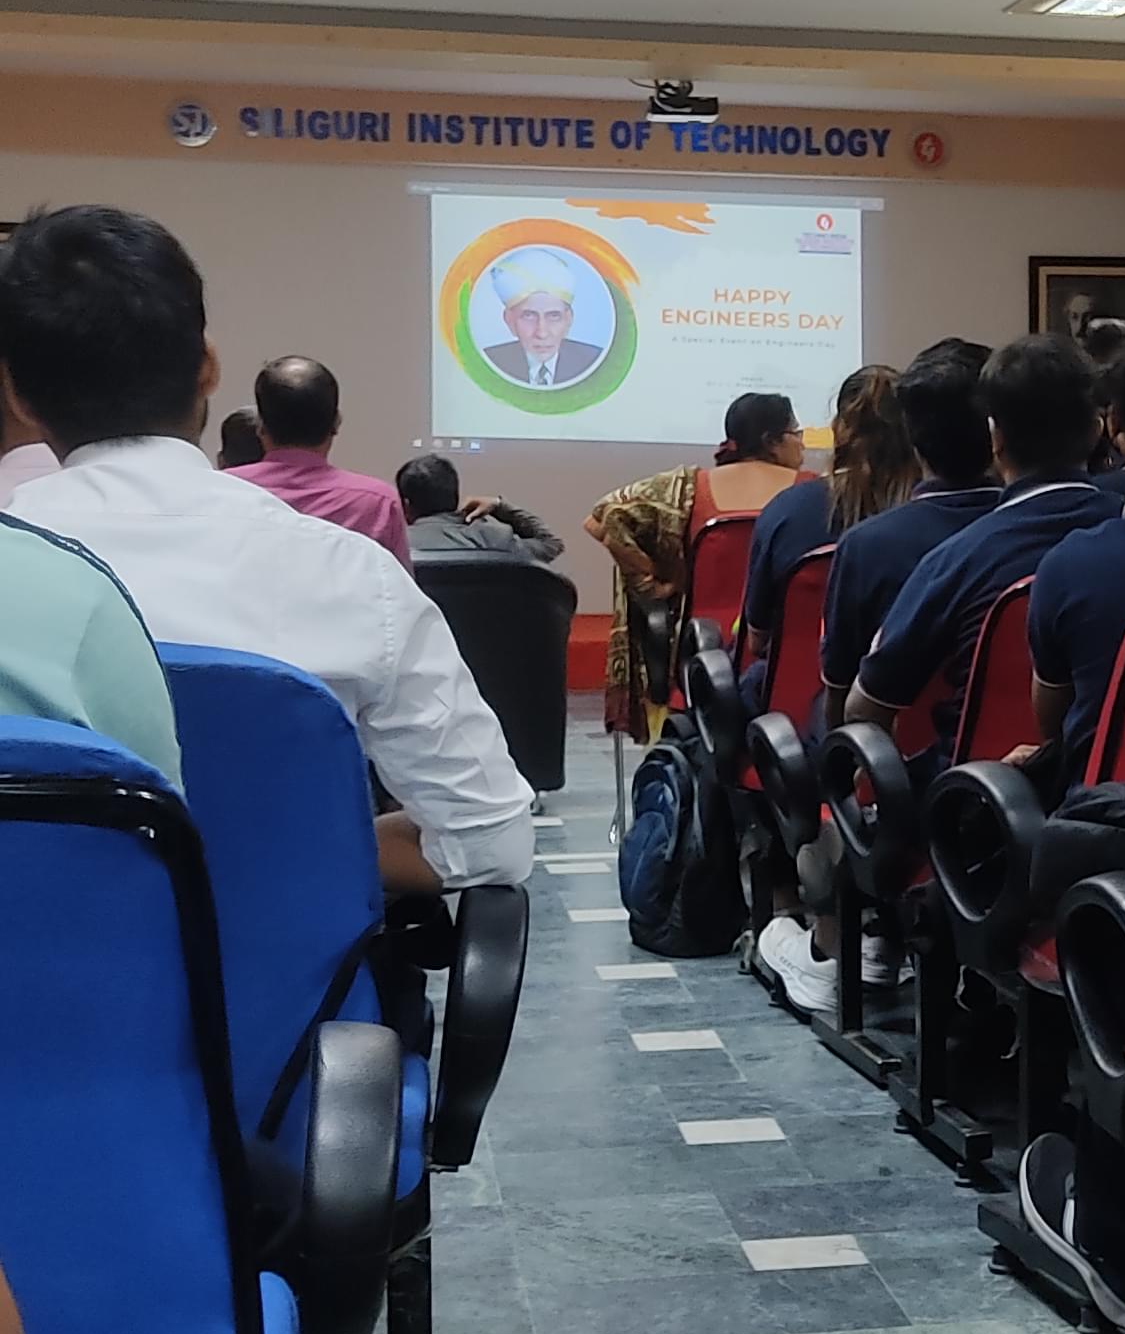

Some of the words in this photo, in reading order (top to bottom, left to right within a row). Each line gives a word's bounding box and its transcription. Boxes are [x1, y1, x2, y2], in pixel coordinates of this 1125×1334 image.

[407, 113, 595, 148] INSTITUTE
[610, 121, 651, 150] OF
[669, 121, 891, 157] TECHNOLOGY
[714, 288, 791, 305] HAPPY
[662, 309, 790, 328] ENGINEERS
[799, 314, 844, 330] DAY
